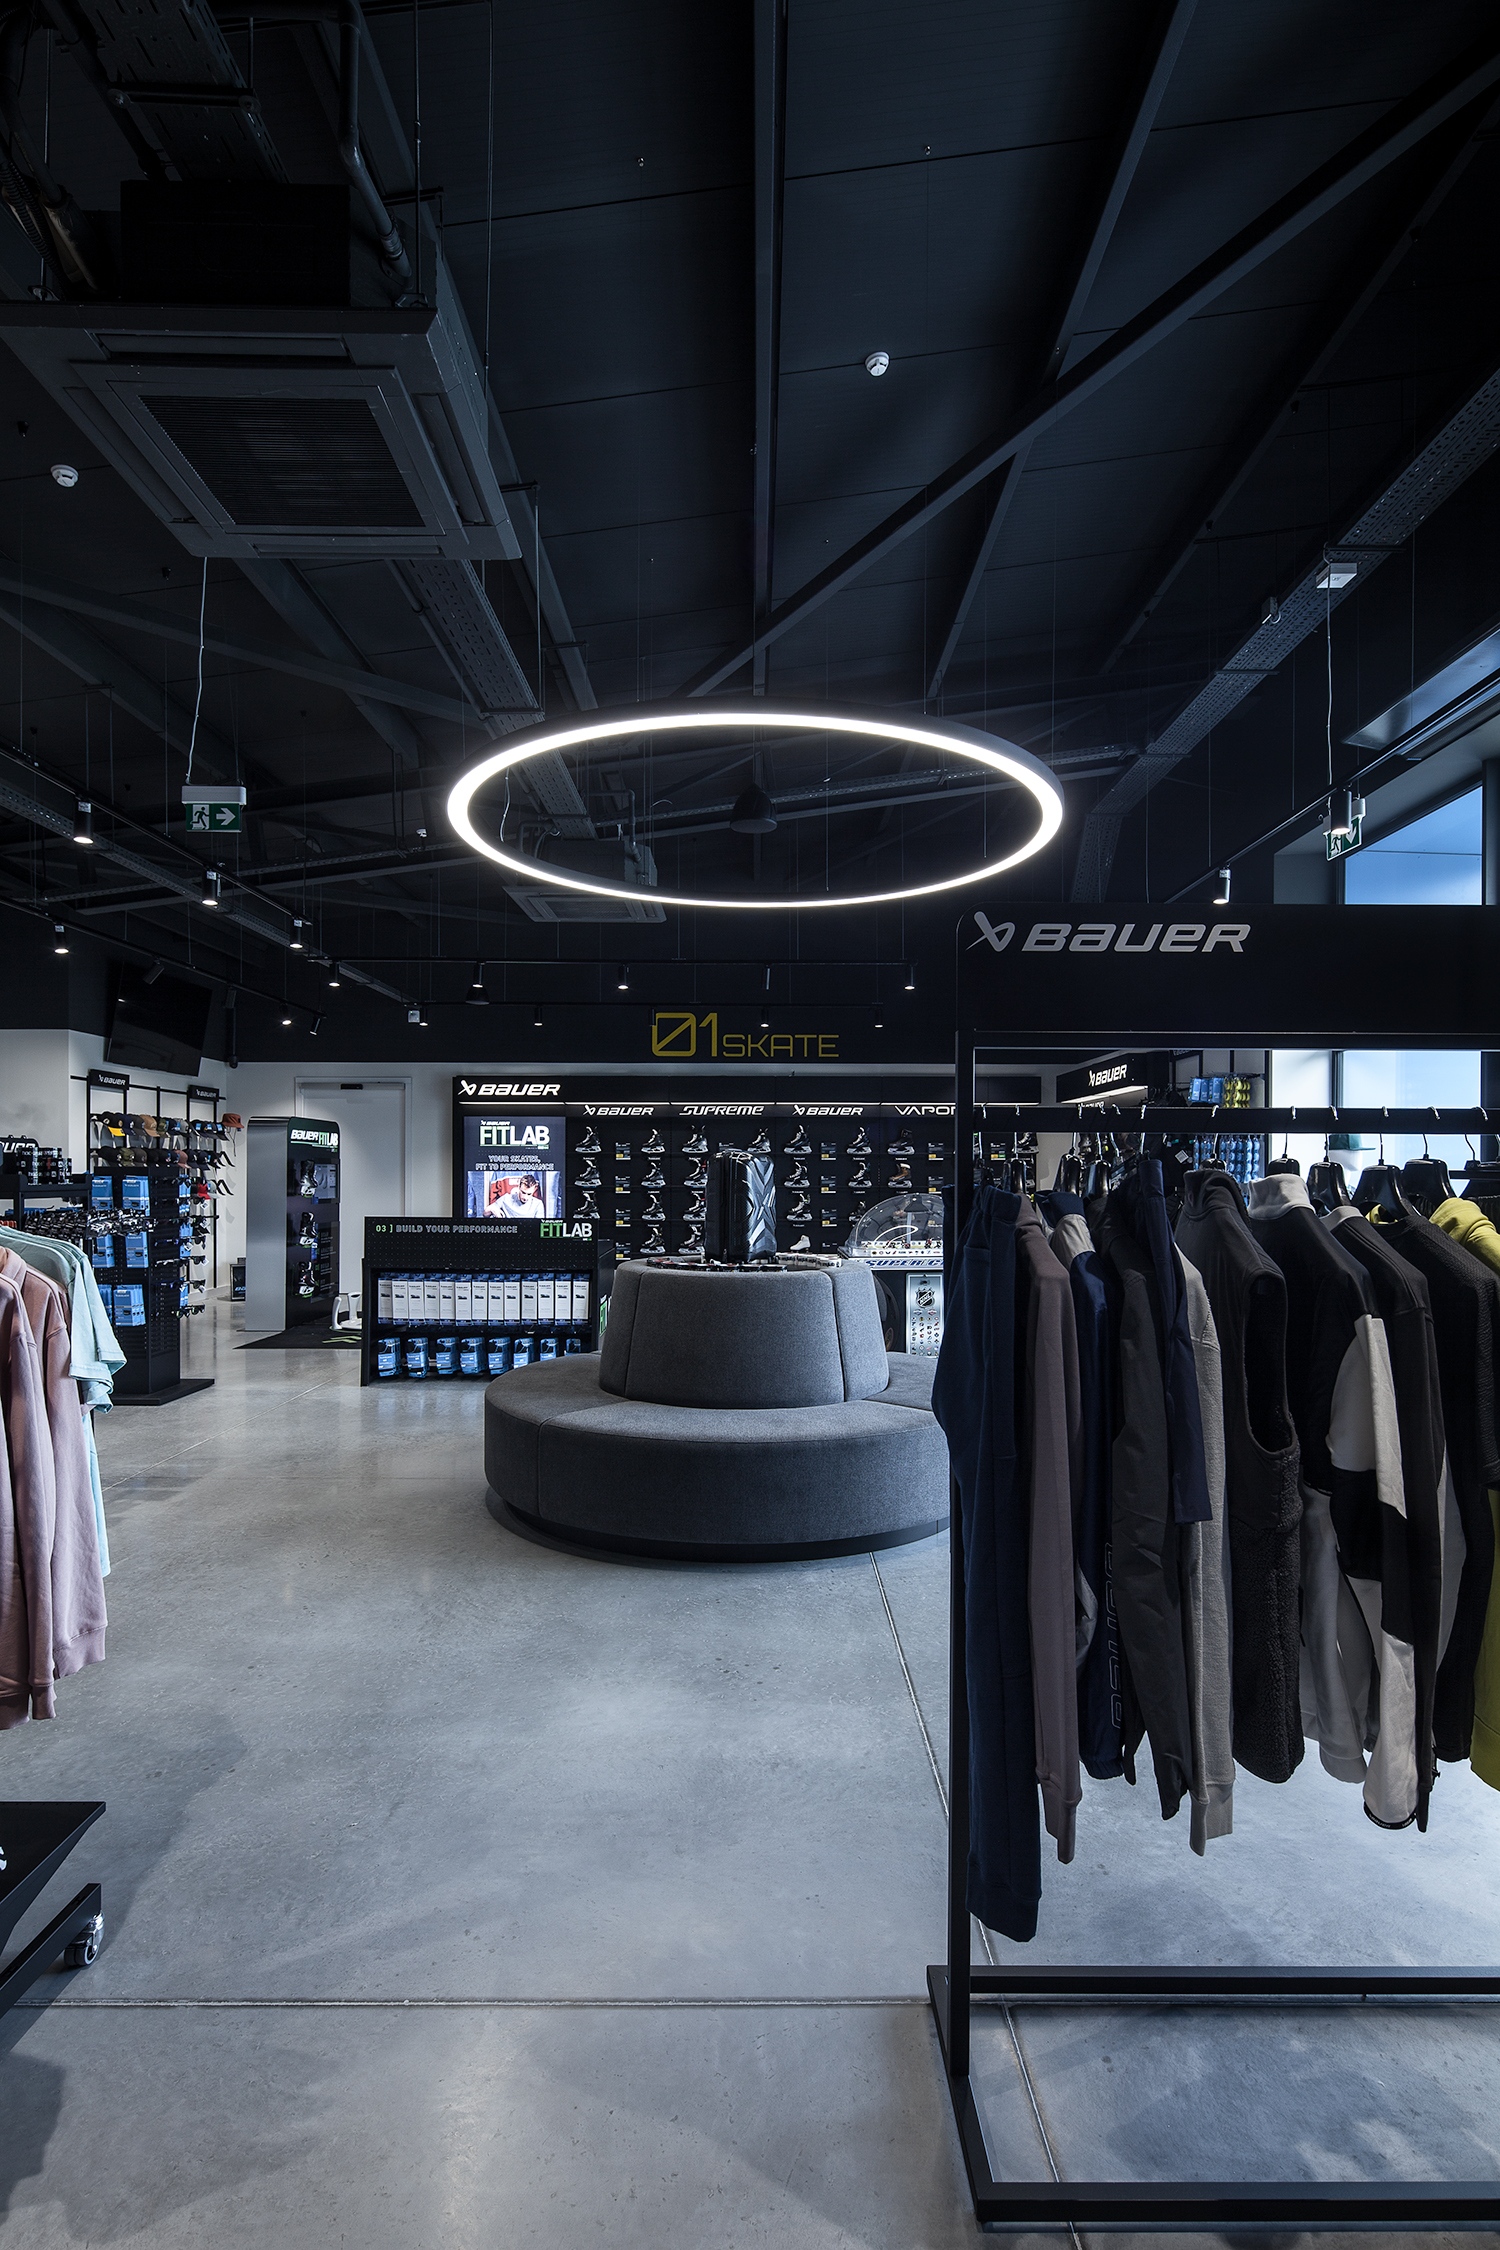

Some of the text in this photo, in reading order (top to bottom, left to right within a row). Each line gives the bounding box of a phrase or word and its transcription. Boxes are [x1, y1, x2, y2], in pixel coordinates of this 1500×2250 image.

[723, 1034, 840, 1057] SKATE
[375, 1224, 387, 1233] 03
[396, 1224, 424, 1233] BUILD
[425, 1224, 450, 1233] YOUR
[452, 1224, 518, 1234] PERFORMANCE
[540, 1222, 593, 1238] FITLAB
